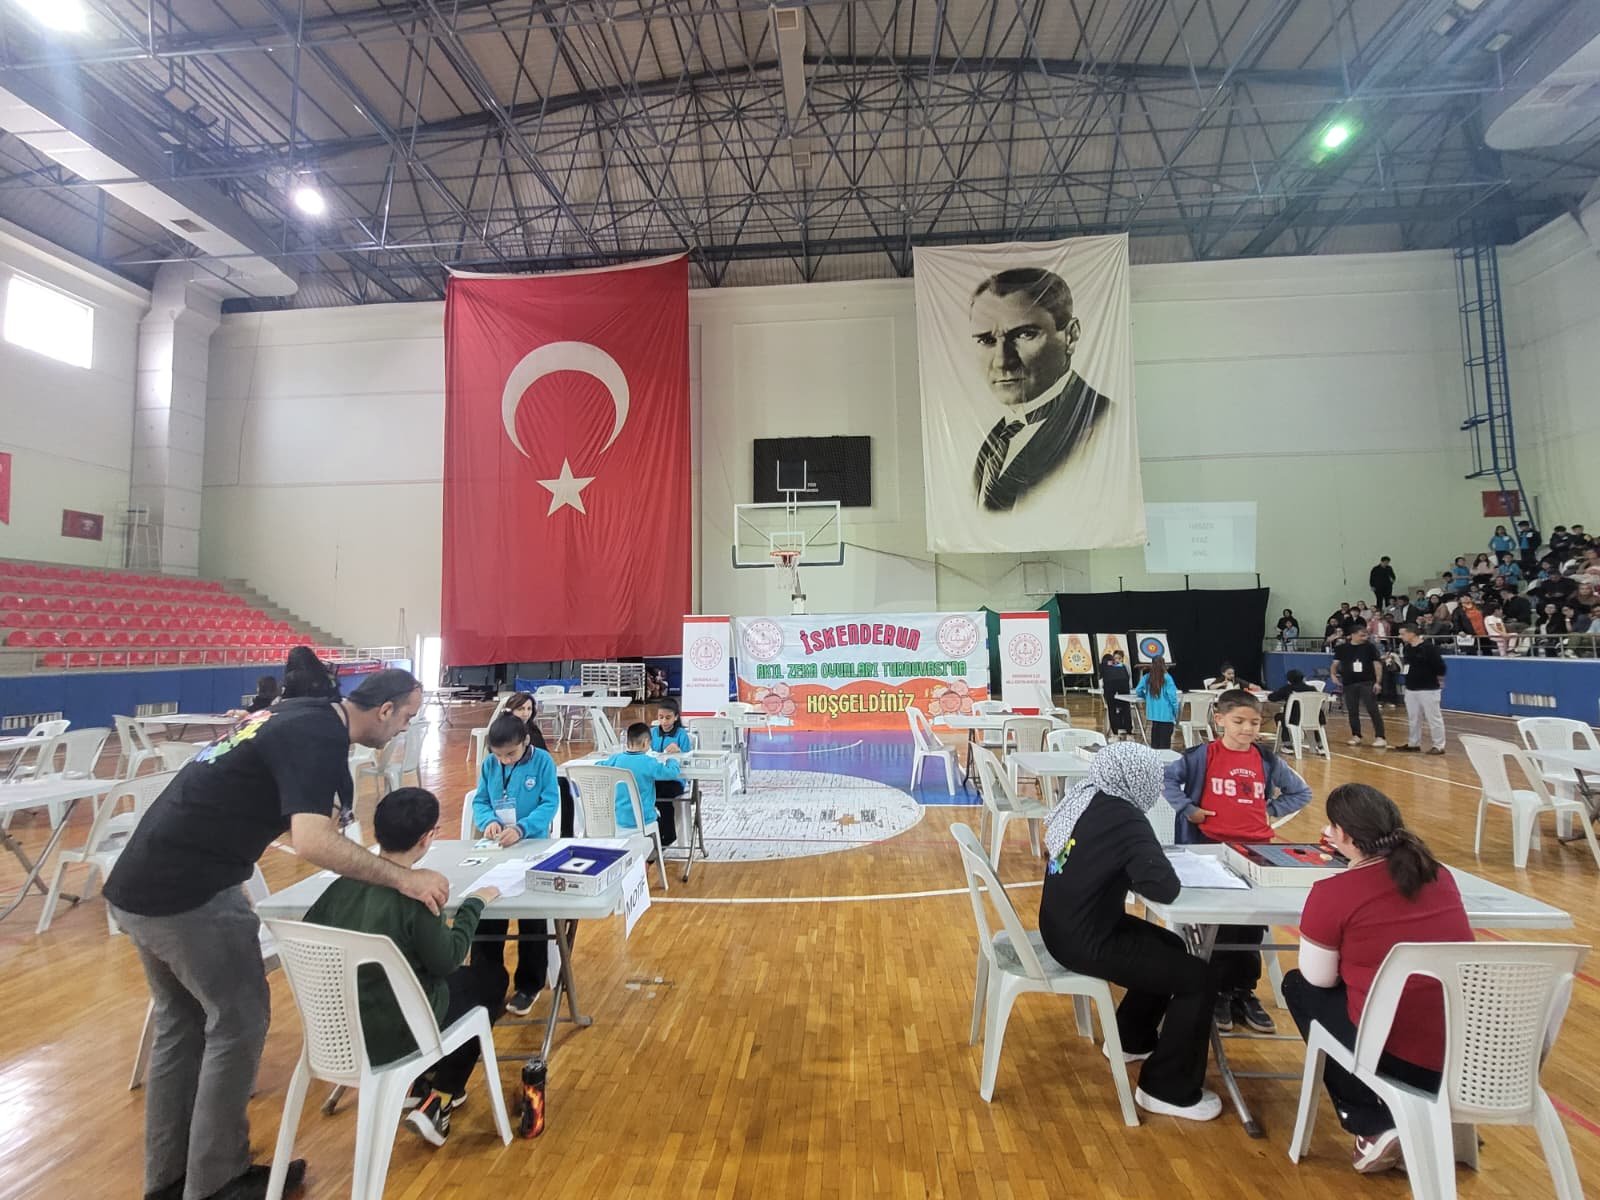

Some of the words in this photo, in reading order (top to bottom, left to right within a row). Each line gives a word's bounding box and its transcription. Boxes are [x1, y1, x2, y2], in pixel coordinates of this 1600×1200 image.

[800, 623, 920, 655] İSKENDERUN
[757, 663, 784, 679] AKIL
[787, 663, 818, 678] ZEKA
[821, 662, 879, 679] OYUNLARI
[882, 661, 967, 677] TURNUVASI'NA
[807, 690, 916, 719] HOŞGELDİNİZ
[1211, 777, 1237, 797] US
